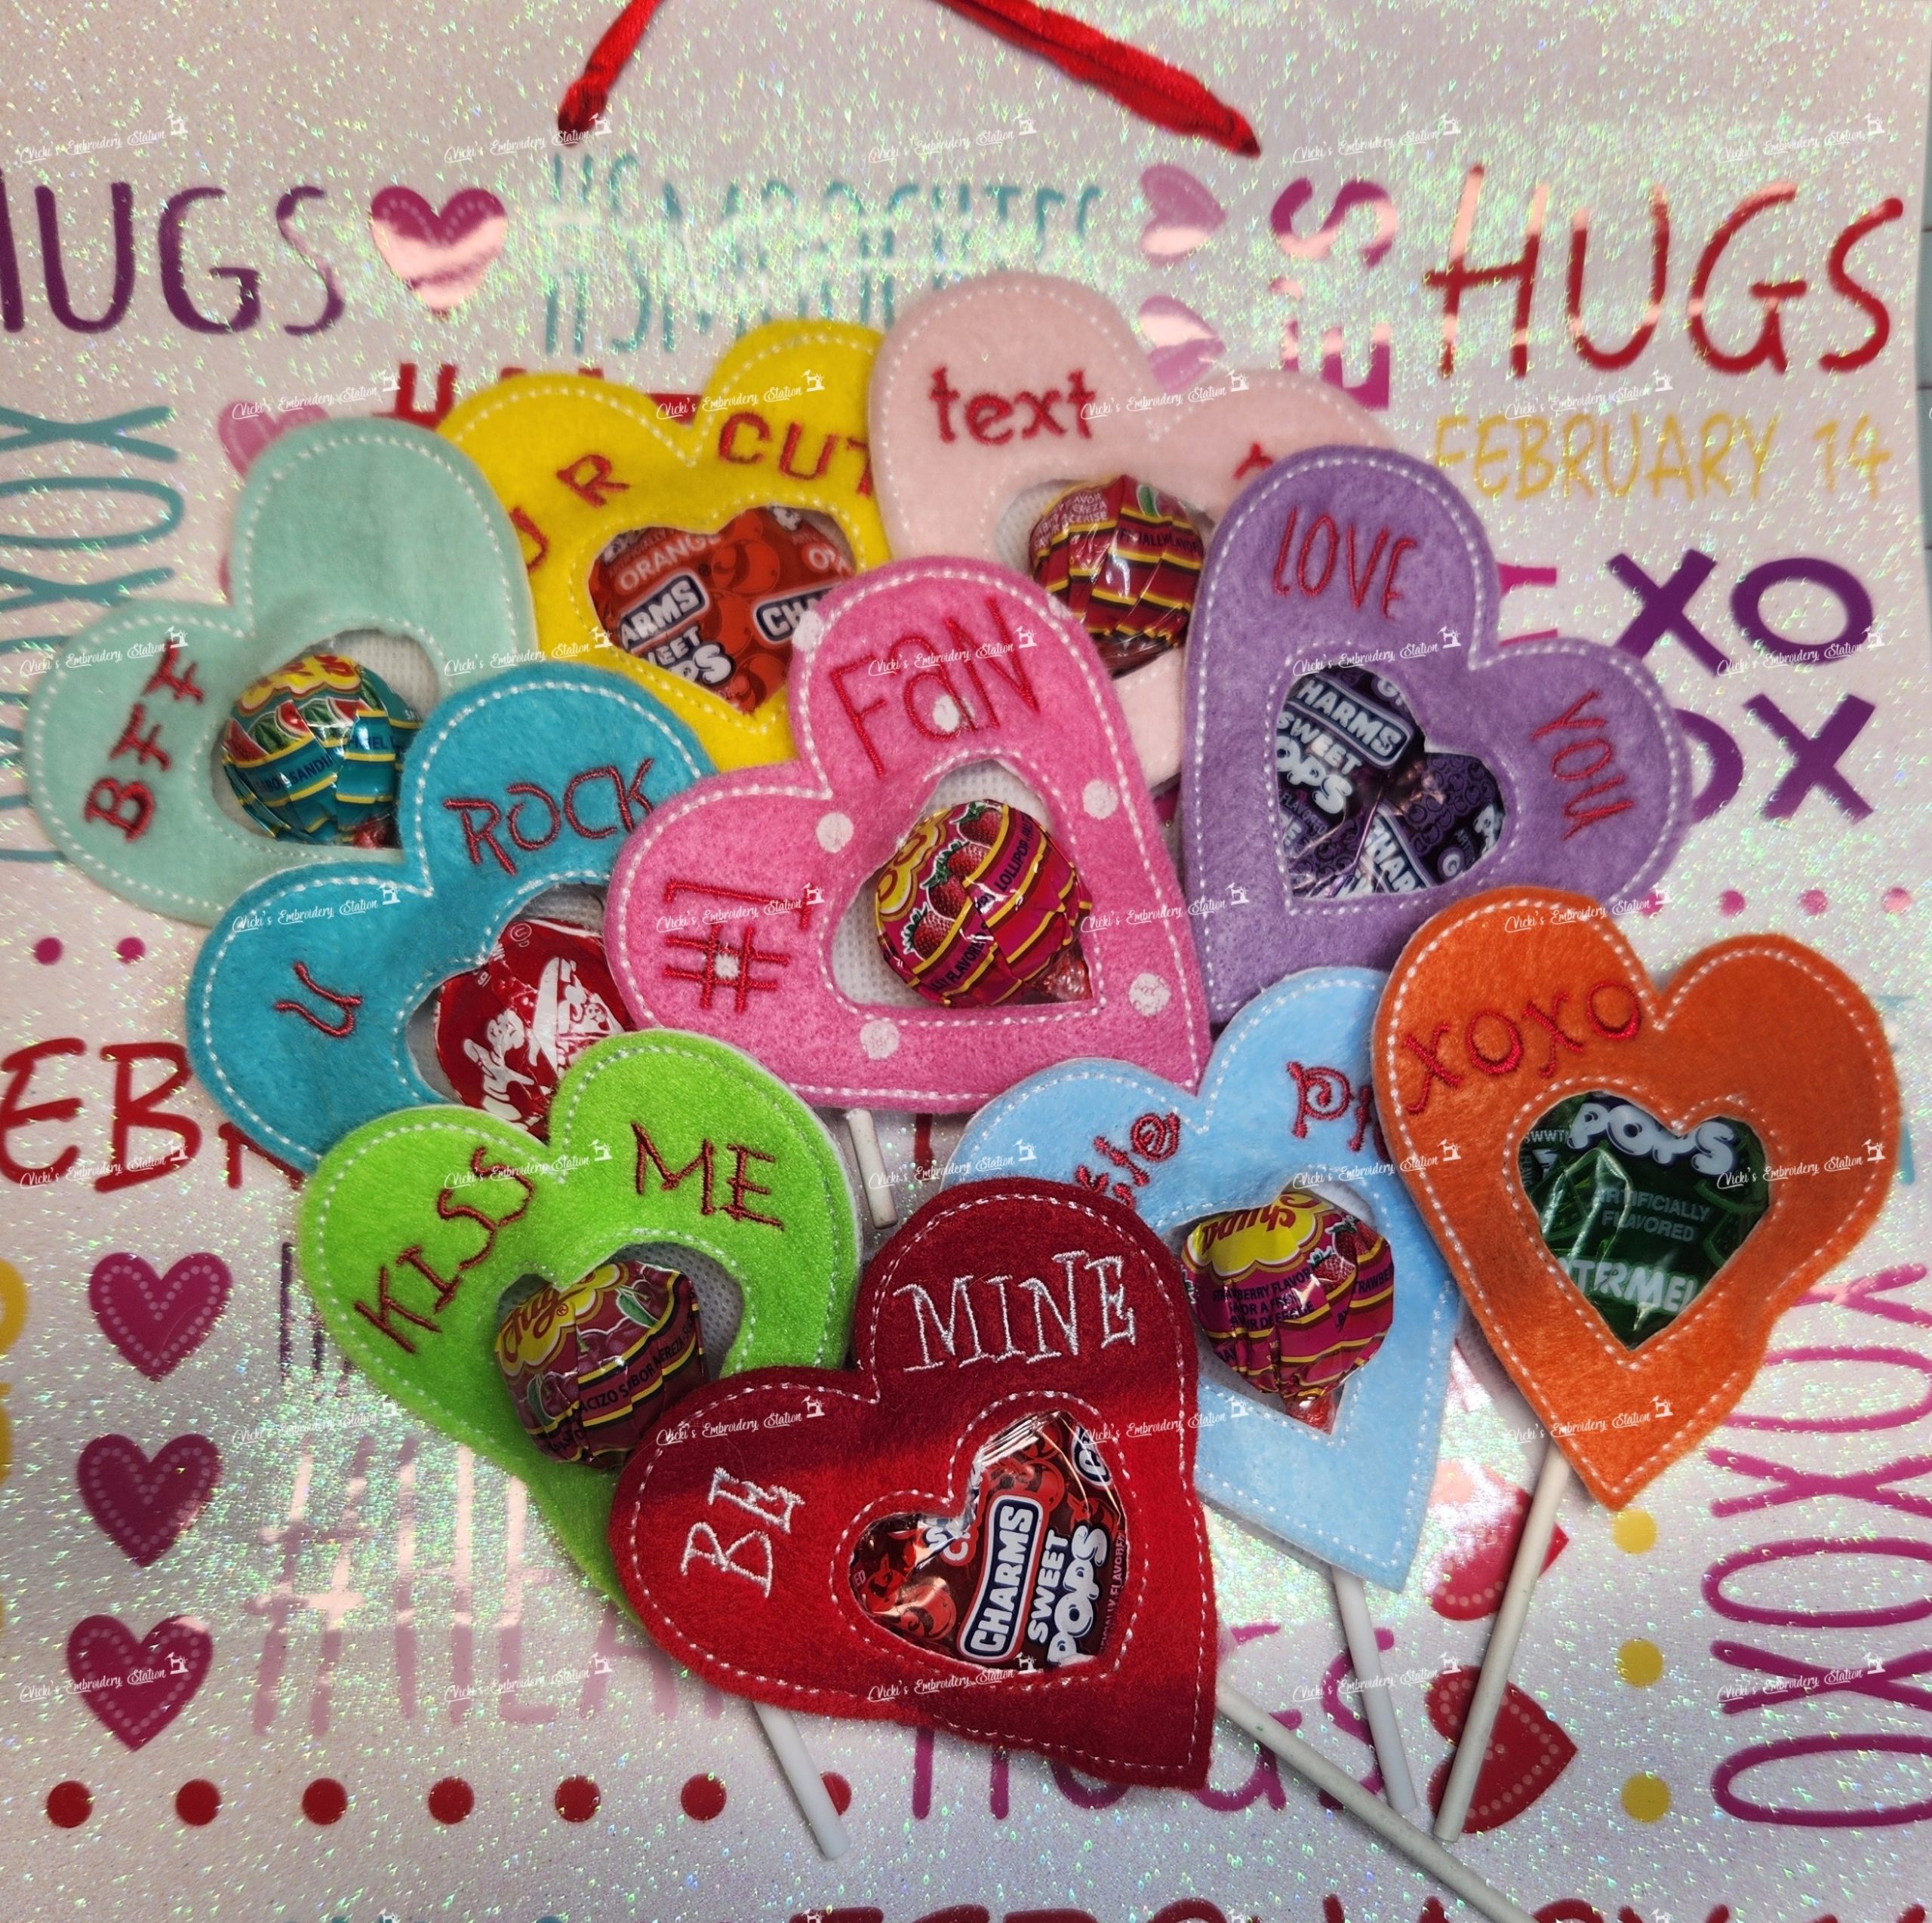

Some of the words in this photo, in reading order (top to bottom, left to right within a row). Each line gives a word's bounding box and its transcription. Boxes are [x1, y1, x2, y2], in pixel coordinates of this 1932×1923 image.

[1423, 163, 1905, 380] HUGS
[928, 365, 1097, 446] text
[1434, 411, 1778, 503] FEBRUARY
[1814, 413, 1894, 503] 14
[555, 453, 631, 511] R
[1272, 506, 1420, 620] LOVE
[1531, 688, 1635, 842] YOU
[1607, 548, 1875, 681] XO
[84, 638, 205, 845] BFF
[443, 757, 658, 875] ROCK
[1405, 979, 1644, 1115] XOXO
[1567, 1102, 1736, 1176] POPS
[354, 1146, 536, 1355] KISS
[630, 1121, 785, 1232] ME
[680, 1465, 808, 1598] BE
[892, 1248, 1137, 1373] MINE
[971, 1503, 1034, 1652] CHARMS
[1028, 1529, 1068, 1644] SWEET
[1047, 1524, 1108, 1666] POPS
